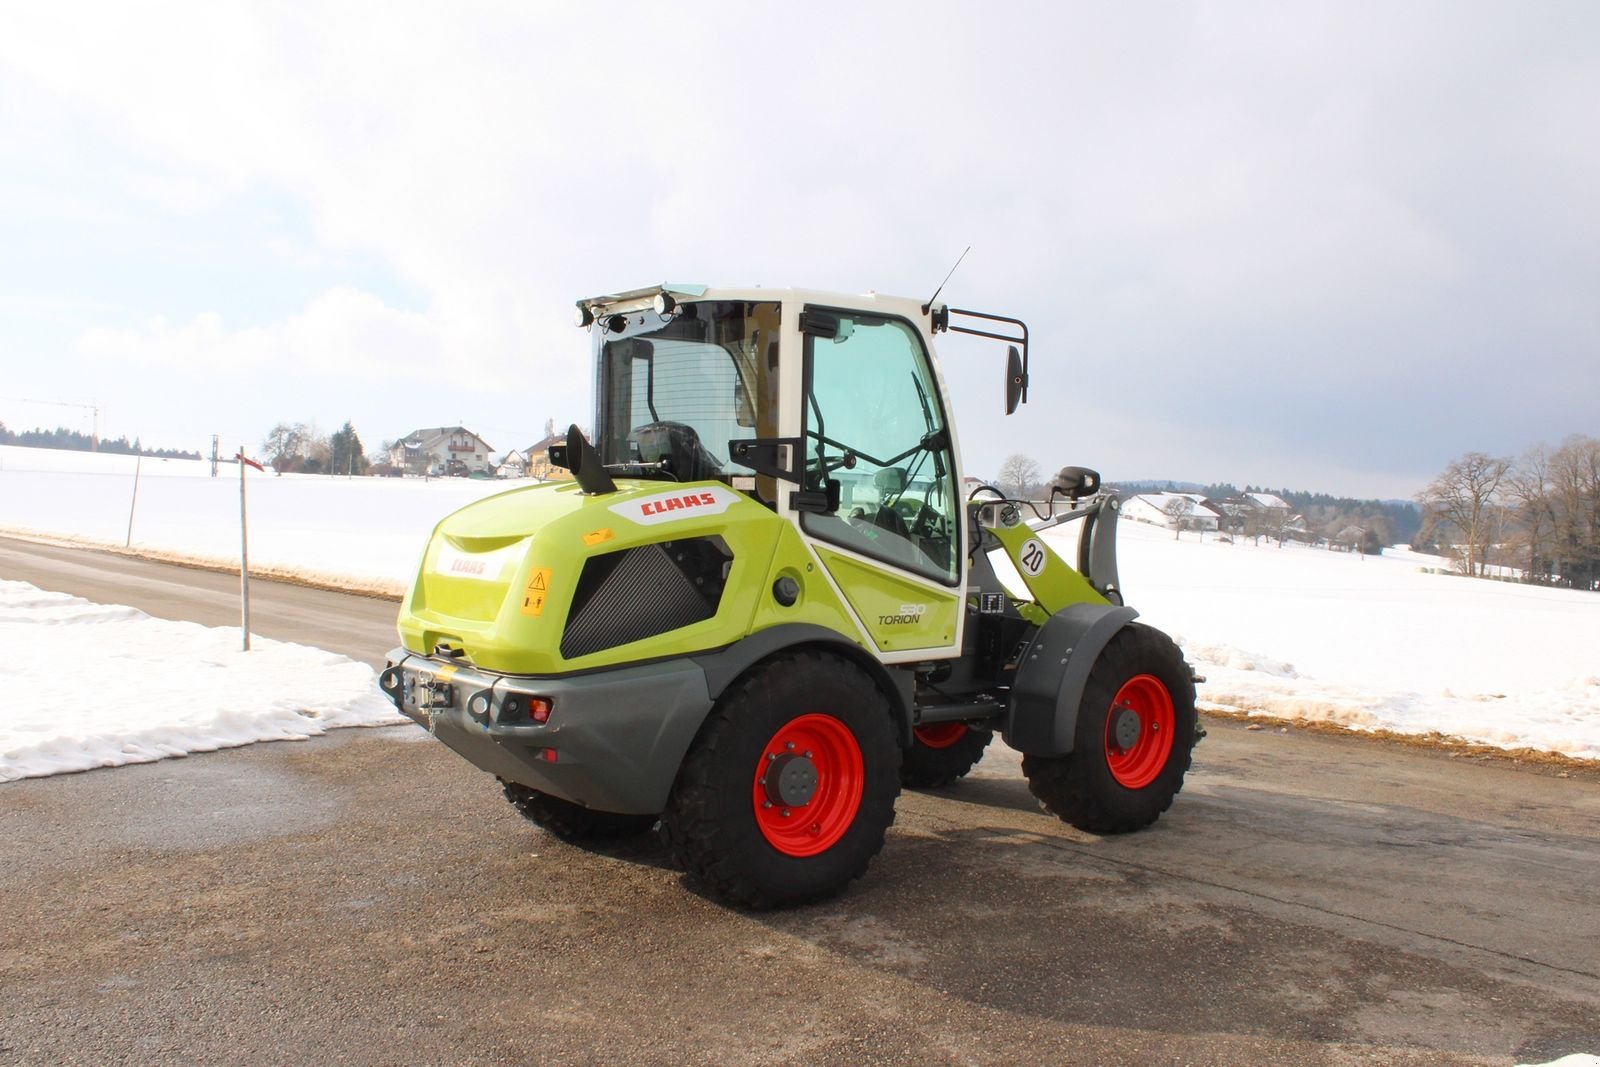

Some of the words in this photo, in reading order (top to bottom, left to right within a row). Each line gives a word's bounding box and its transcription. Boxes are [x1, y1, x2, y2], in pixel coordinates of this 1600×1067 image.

[641, 493, 716, 516] CLAAS
[451, 559, 487, 575] CLAAS
[1022, 543, 1043, 572] 20
[878, 614, 920, 625] TORION
